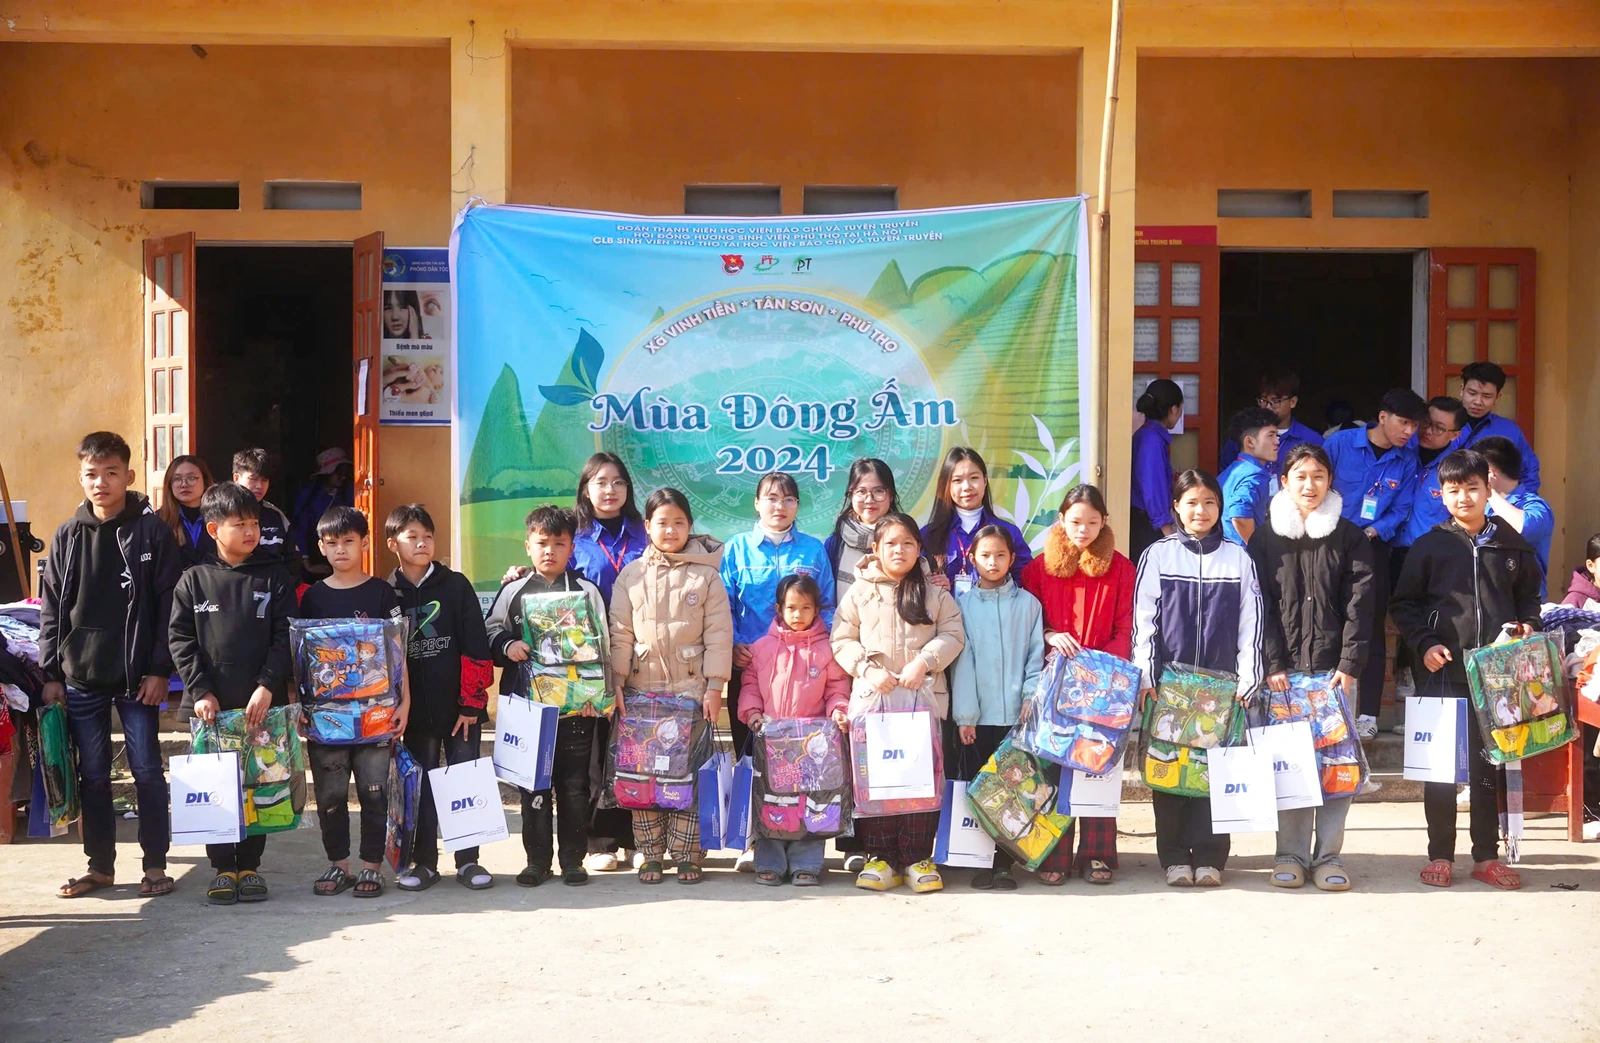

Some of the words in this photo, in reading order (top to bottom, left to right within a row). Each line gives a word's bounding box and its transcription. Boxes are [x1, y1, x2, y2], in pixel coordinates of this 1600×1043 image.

[644, 335, 668, 354] Xã
[664, 313, 704, 338] VINH
[702, 300, 738, 320] TIỀN
[754, 295, 786, 310] TÂN
[790, 299, 824, 315] SƠN
[838, 312, 872, 333] PHÚ
[869, 328, 899, 353] THỌ
[588, 386, 712, 432] Mùa
[720, 392, 860, 440] Đông
[863, 376, 960, 431] Ấm
[715, 444, 835, 482] 2024
[253, 591, 271, 615] 7
